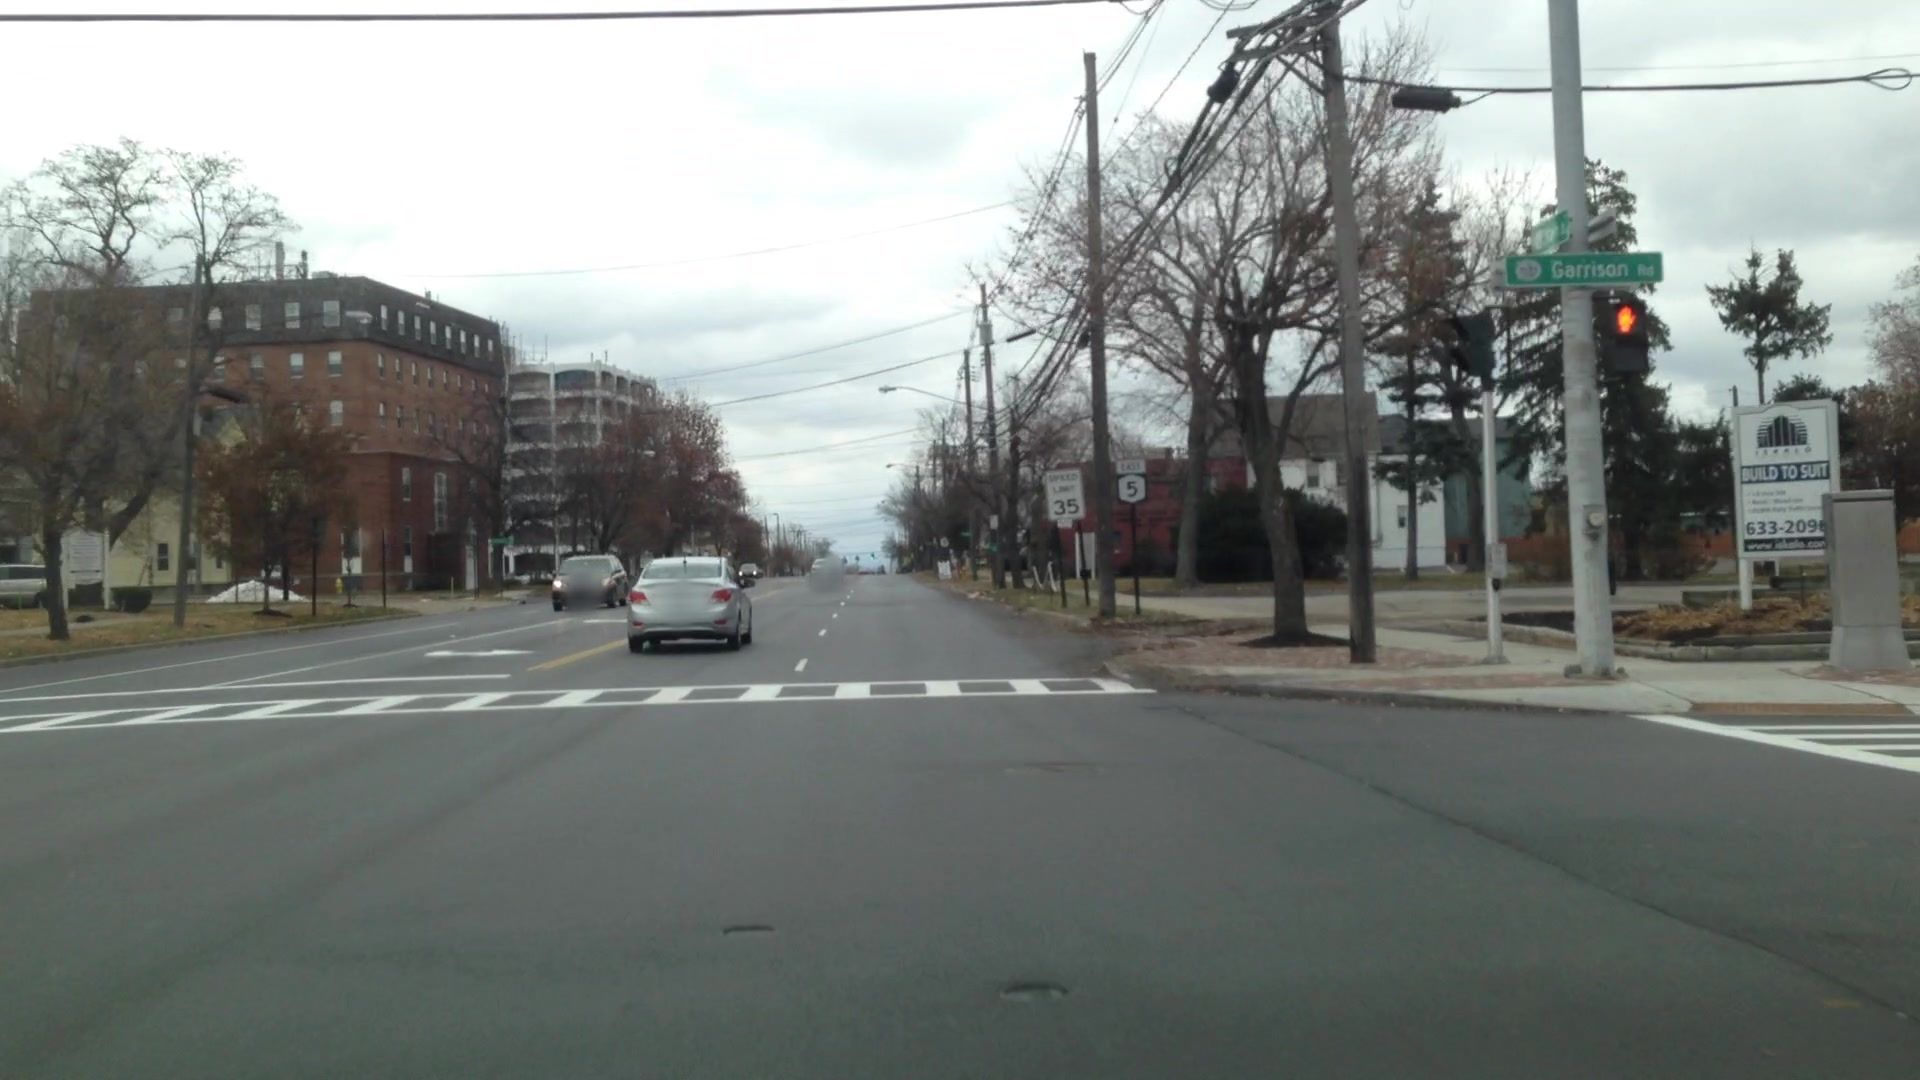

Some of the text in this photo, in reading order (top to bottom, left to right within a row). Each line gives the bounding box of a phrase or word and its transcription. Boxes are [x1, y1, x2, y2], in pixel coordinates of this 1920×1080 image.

[1552, 261, 1628, 279] Garrison
[1638, 265, 1654, 277] Rd
[1049, 473, 1078, 482] SPEED
[1743, 463, 1828, 482] BUILD TO SUIT
[1053, 485, 1074, 493] LIMIT
[1126, 481, 1138, 498] 5
[1054, 499, 1079, 515] 35
